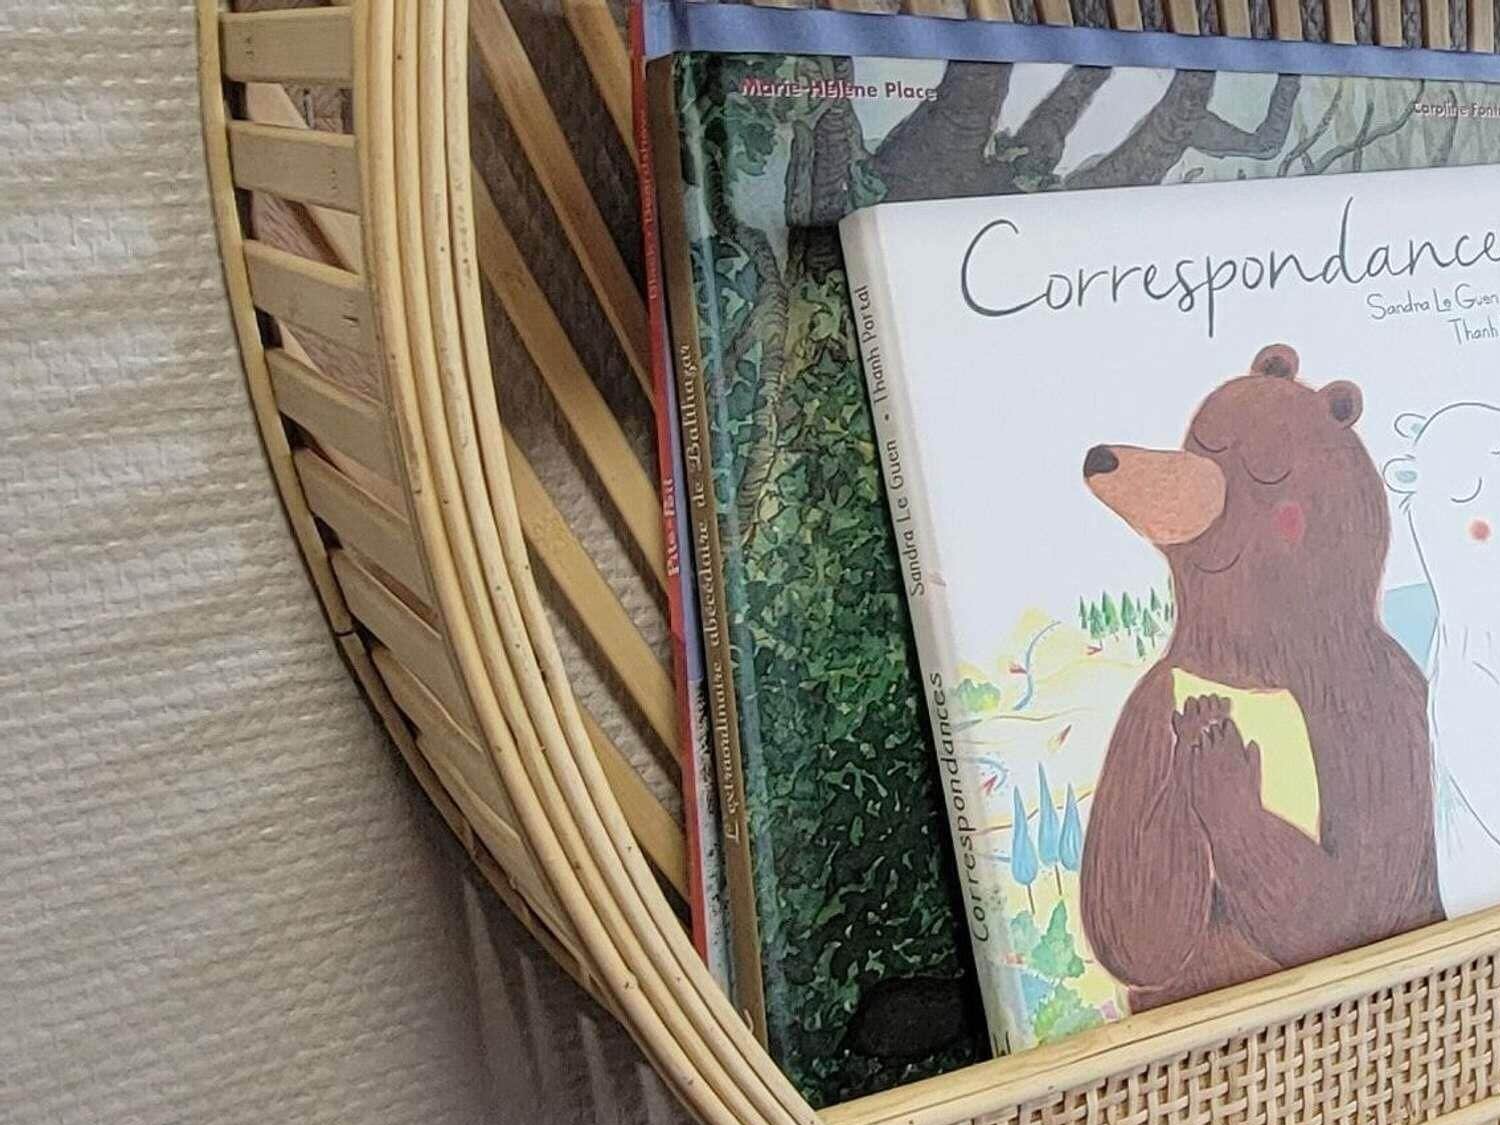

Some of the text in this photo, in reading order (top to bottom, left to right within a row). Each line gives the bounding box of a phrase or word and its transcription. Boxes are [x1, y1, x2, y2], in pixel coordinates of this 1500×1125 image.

[885, 80, 938, 101] Place
[1366, 283, 1499, 320] Sandra Le Guen
[1447, 316, 1498, 345] Thanh
[678, 343, 702, 472] Balthazar
[853, 284, 925, 596] Sandra Le Guen Thanh Portal
[690, 479, 705, 508] de
[928, 672, 990, 943] Correspondances
